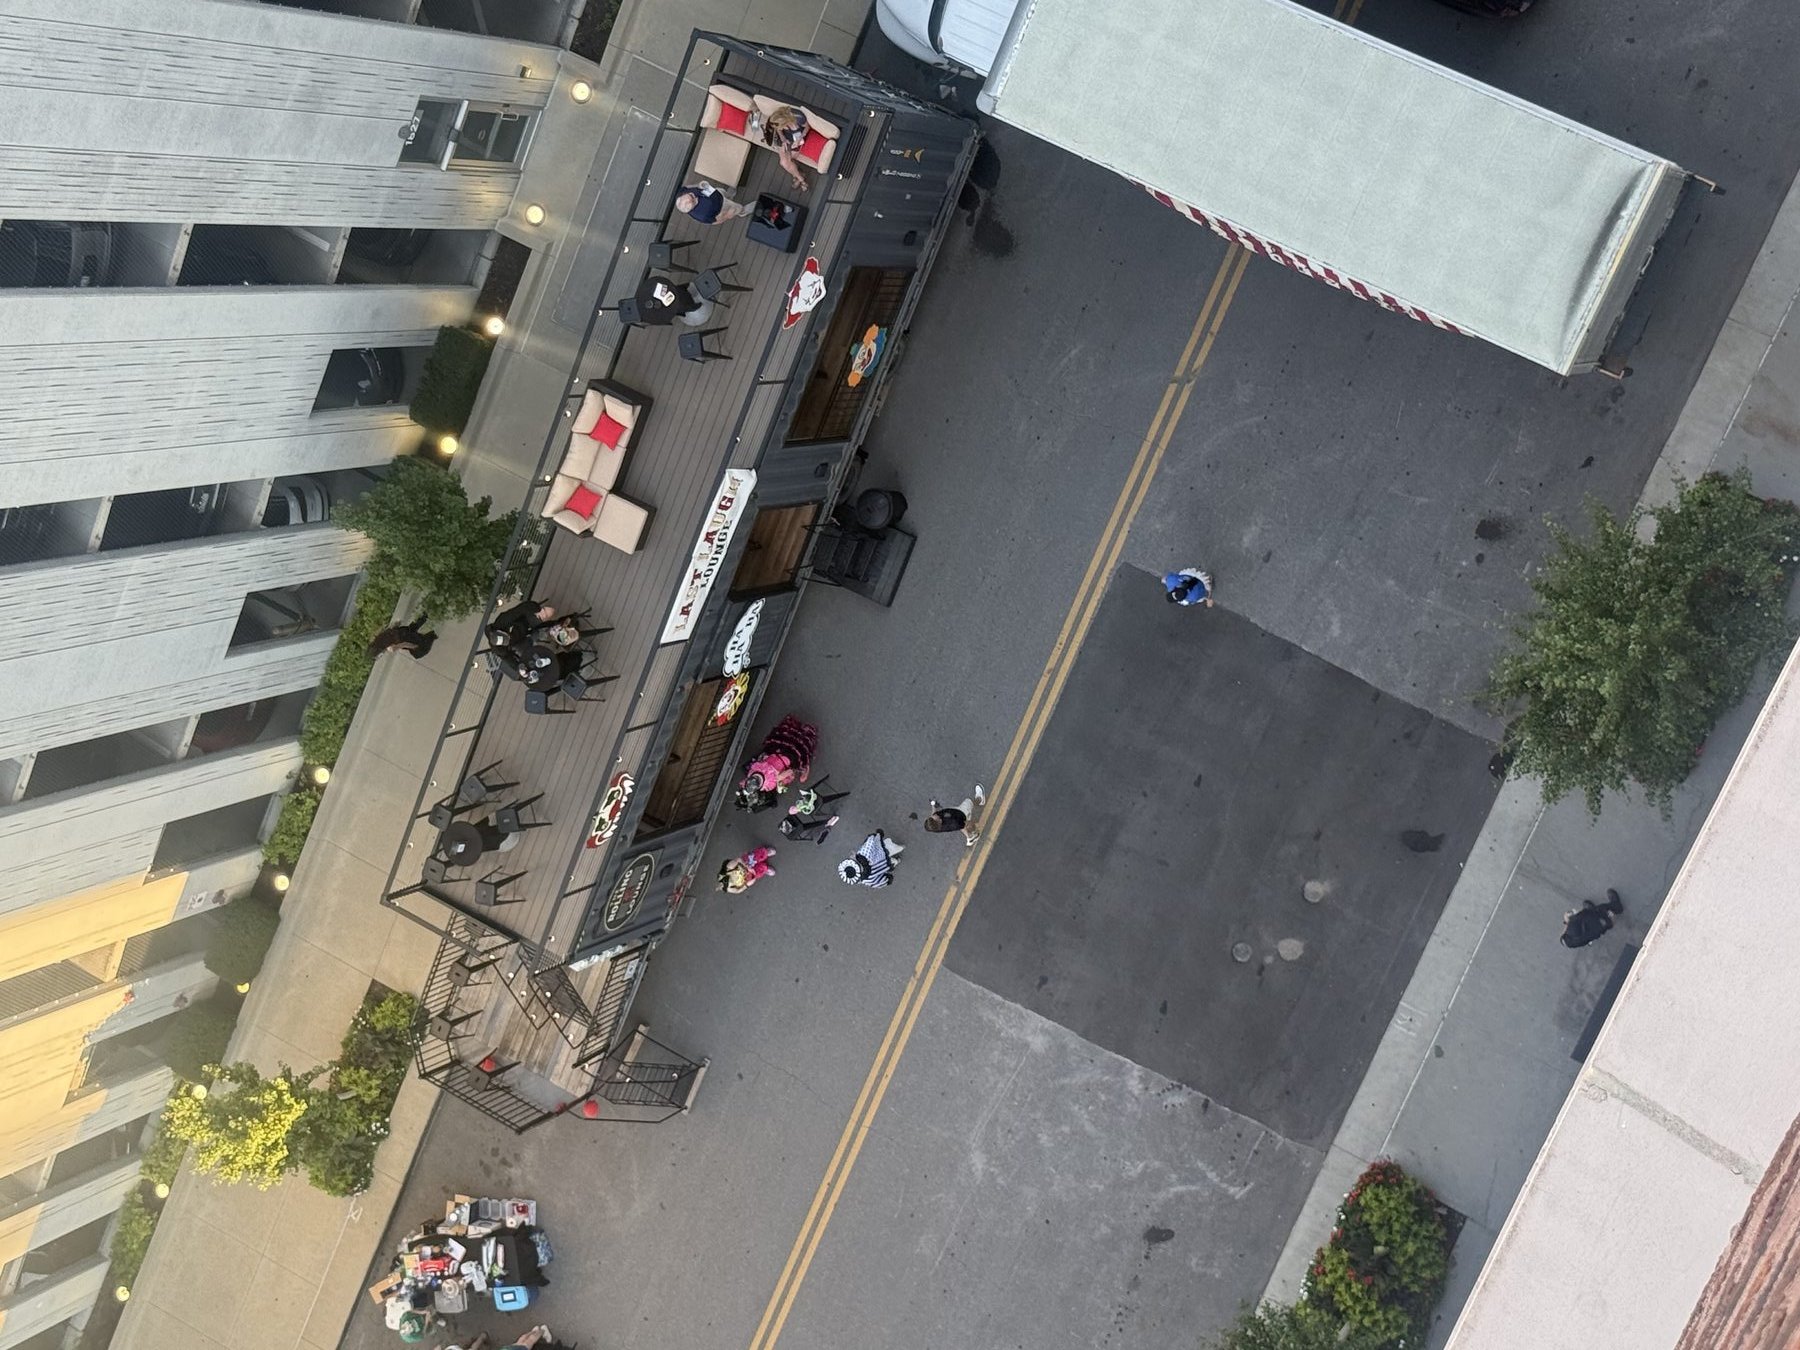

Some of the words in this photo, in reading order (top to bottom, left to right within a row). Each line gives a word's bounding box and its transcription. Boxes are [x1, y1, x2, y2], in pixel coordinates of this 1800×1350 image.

[405, 116, 420, 146] 1627
[674, 568, 703, 635] LAST
[697, 476, 744, 562] LAUGH
[701, 519, 733, 589] LOUNGE
[730, 628, 744, 651] HA
[733, 641, 745, 665] HA
[746, 605, 760, 627] HA
[607, 869, 633, 923] ROLLING
[626, 864, 650, 915] LOUNGE
